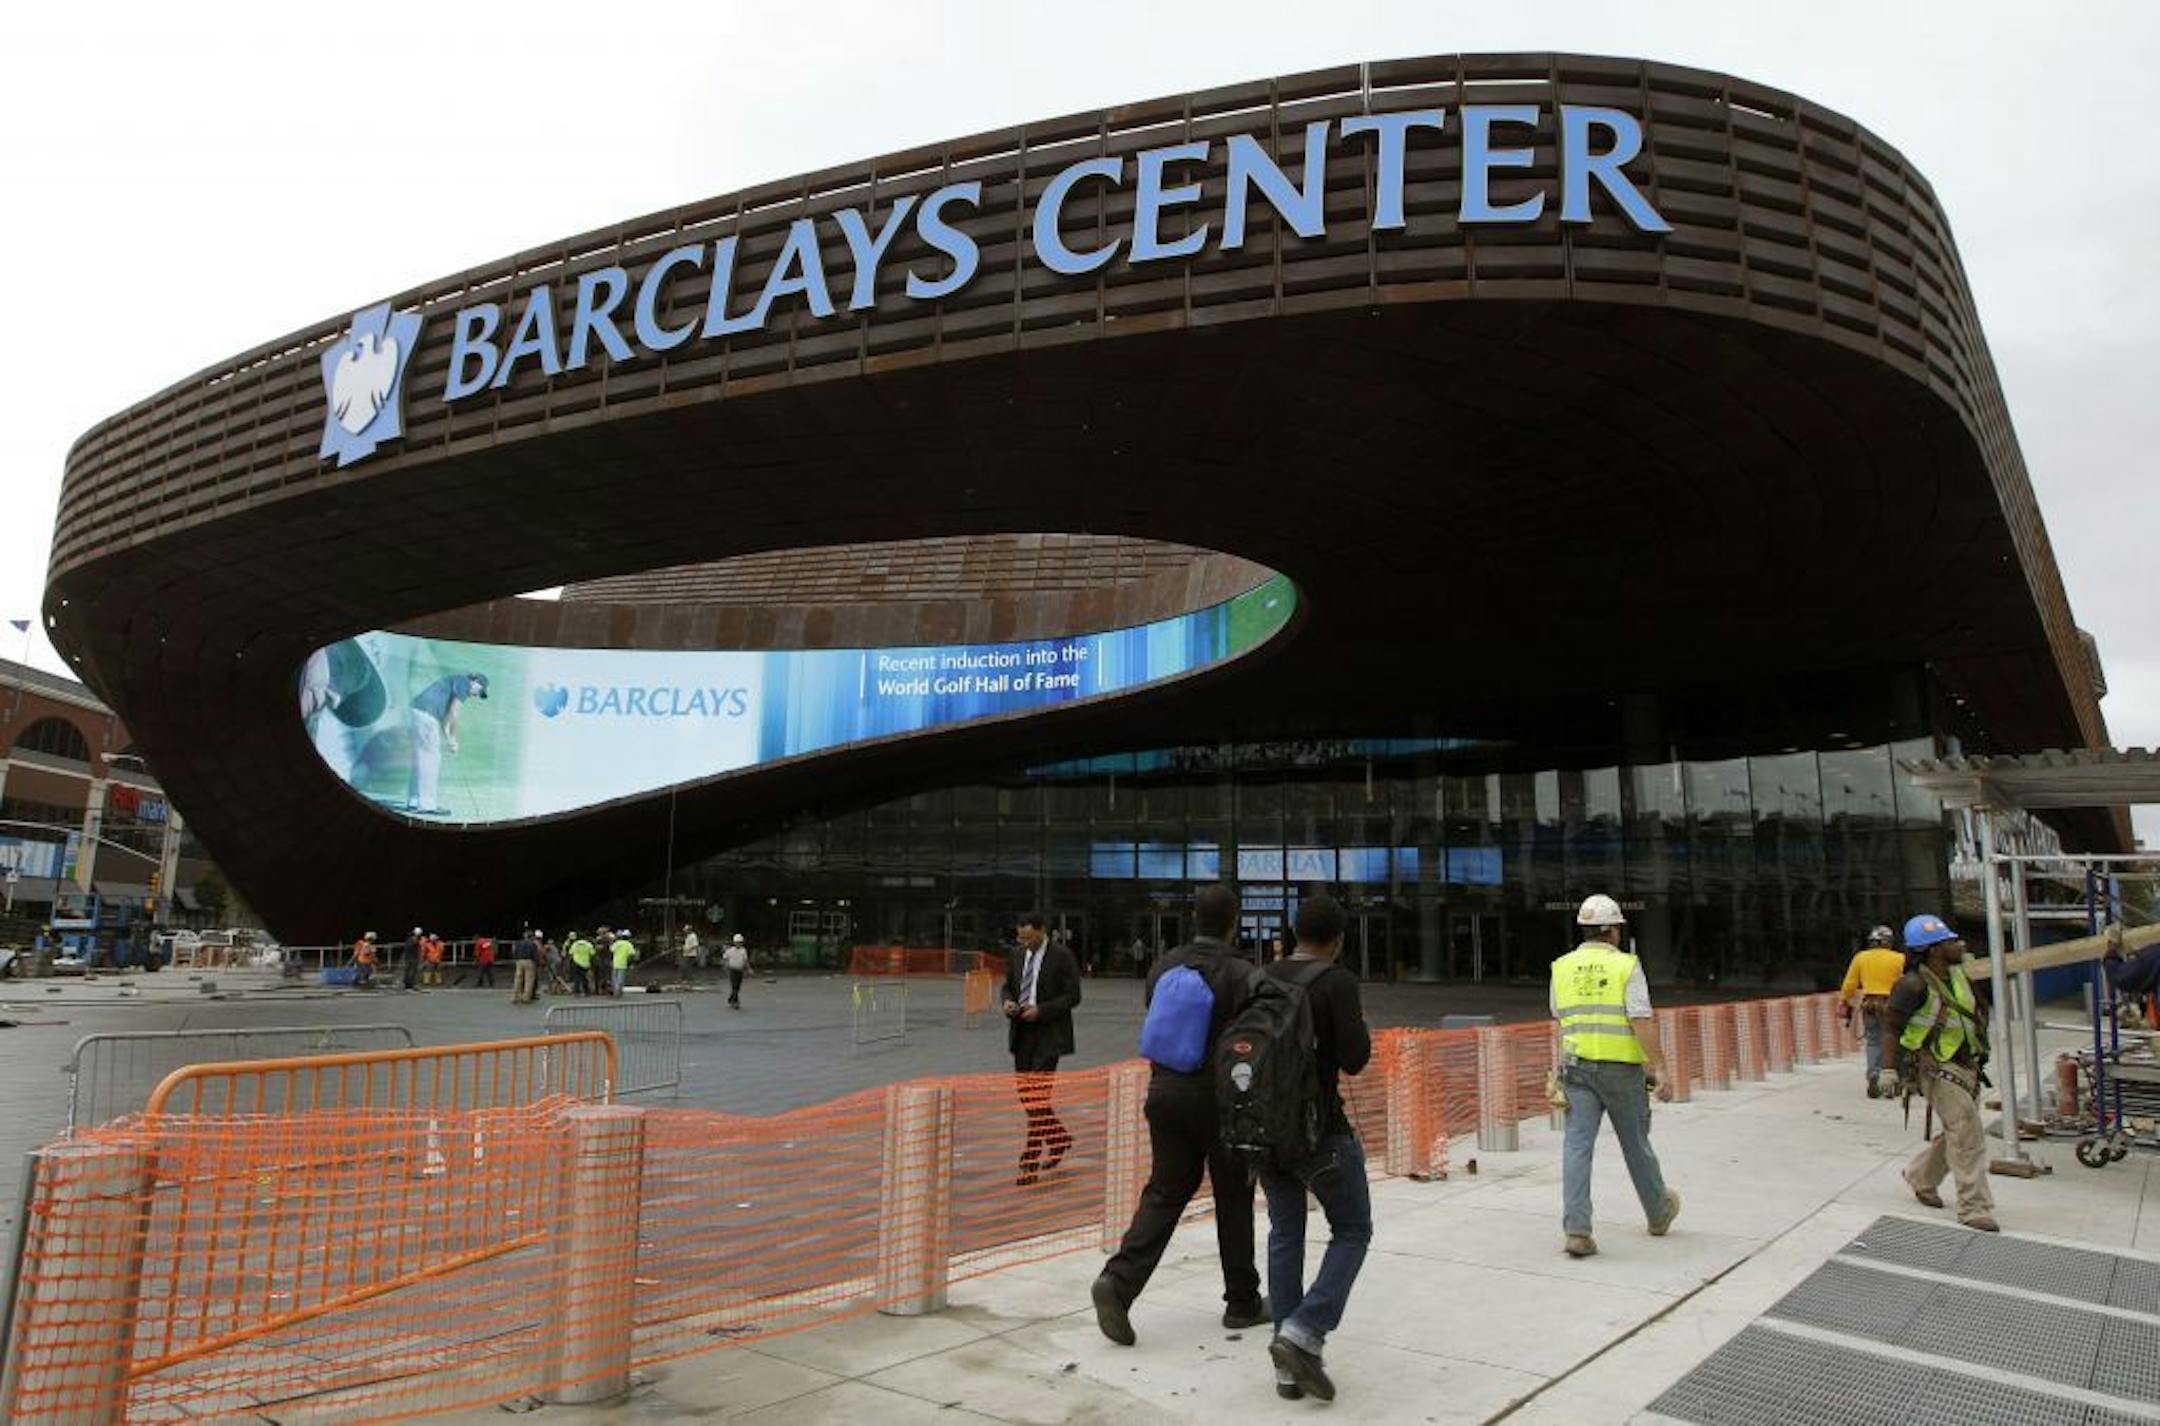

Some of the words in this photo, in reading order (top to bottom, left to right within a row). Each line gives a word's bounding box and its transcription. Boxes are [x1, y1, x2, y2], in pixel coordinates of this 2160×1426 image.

[443, 181, 982, 402] BARCLAYS
[1032, 104, 1674, 275] CENTER
[878, 655, 936, 671] Recent
[941, 651, 1020, 669] induction
[1026, 648, 1058, 666] into
[1062, 645, 1088, 662] the
[878, 678, 929, 695] World
[934, 676, 971, 694] Golf
[975, 674, 1008, 692] Hall
[1013, 672, 1032, 690] of
[1036, 671, 1080, 689] Fame
[576, 686, 749, 718] BARCLAYS
